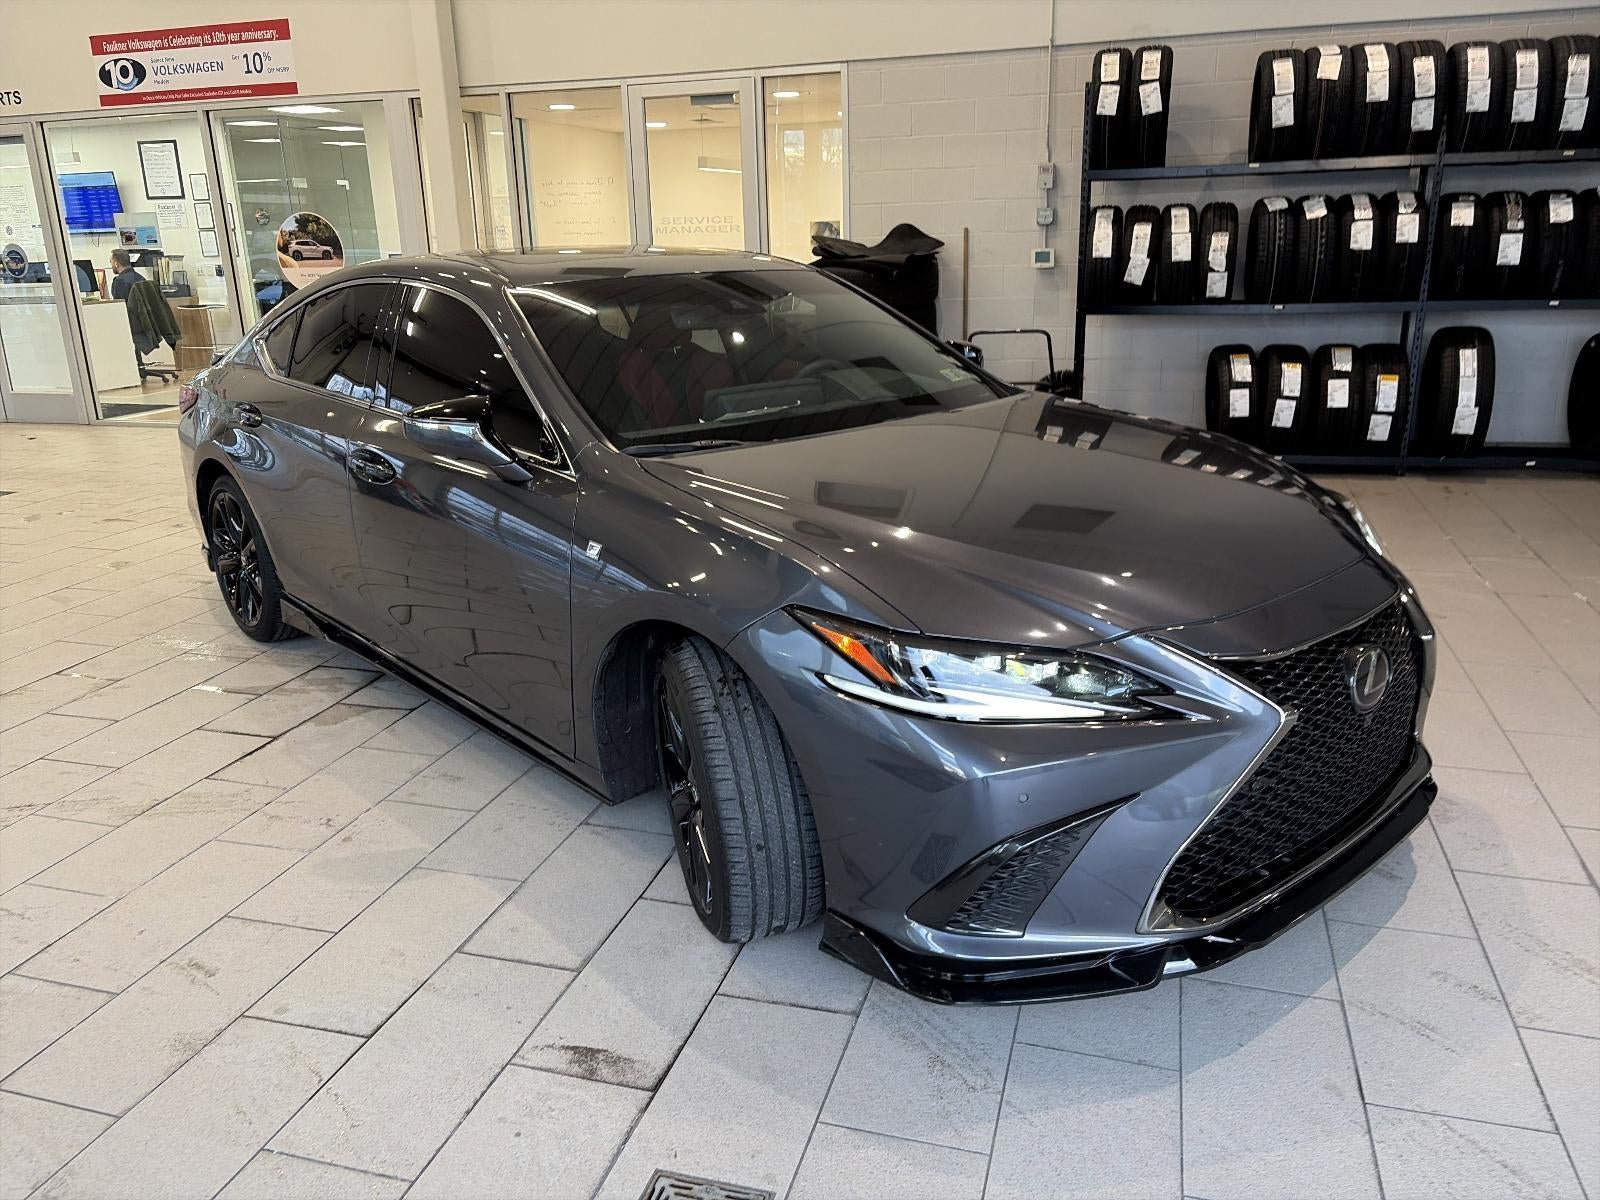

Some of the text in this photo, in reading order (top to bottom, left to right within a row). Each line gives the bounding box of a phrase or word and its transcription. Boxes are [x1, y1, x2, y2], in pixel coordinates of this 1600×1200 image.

[102, 40, 127, 53] Faulkner
[127, 38, 162, 51] Volkswagen
[168, 34, 203, 47] Celebrating
[212, 30, 227, 43] 10th
[227, 32, 240, 45] year
[104, 59, 135, 90] 10
[151, 60, 224, 77] VOLKSWAGEN
[661, 215, 734, 225] SERVICE
[656, 224, 741, 235] MANAGER
